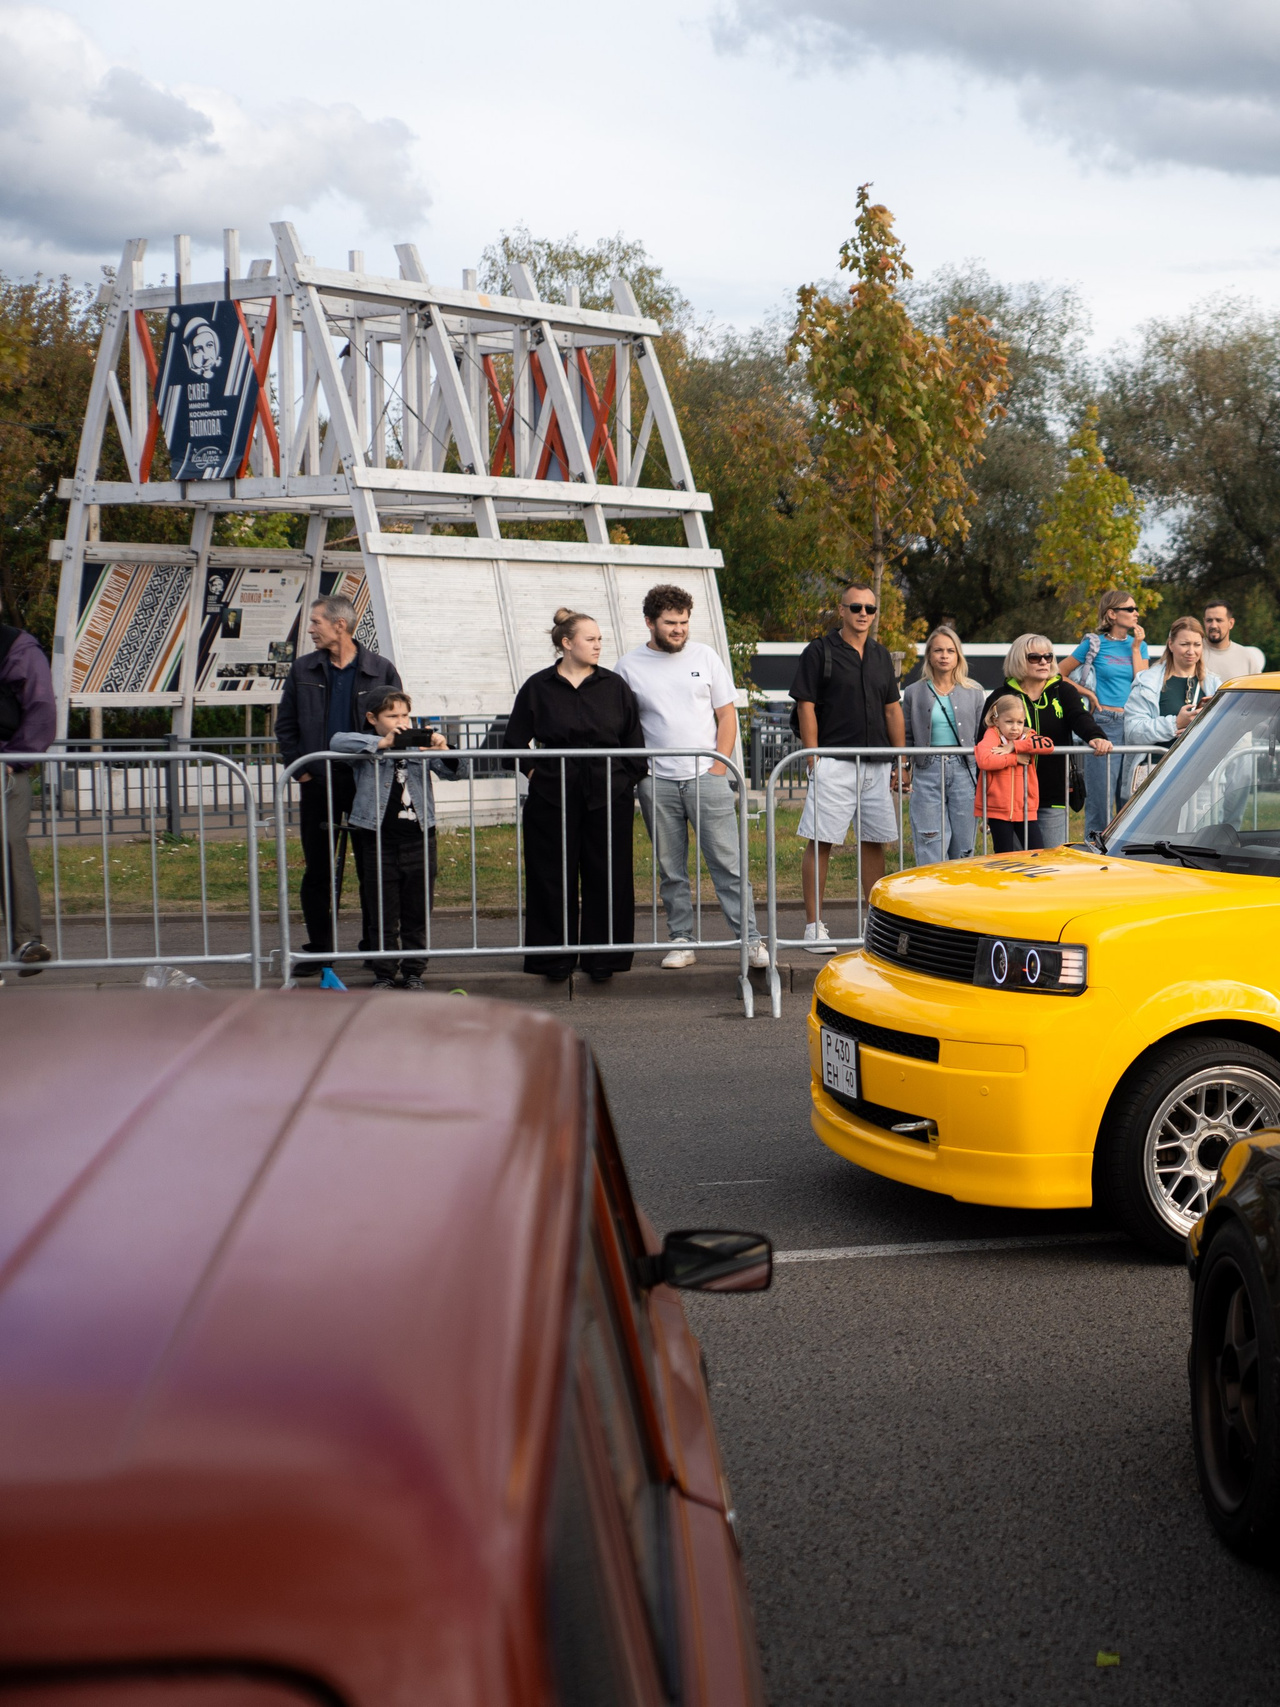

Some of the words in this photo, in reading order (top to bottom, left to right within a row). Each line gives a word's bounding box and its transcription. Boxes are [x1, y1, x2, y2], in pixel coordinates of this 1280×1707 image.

[188, 383, 209, 400] СКВЕР
[190, 418, 221, 436] ВОЛКОВА
[87, 604, 114, 635] КАЛУГА
[101, 574, 127, 605] КАЛУГА
[835, 1038, 850, 1063] 430
[845, 1070, 854, 1088] 40
